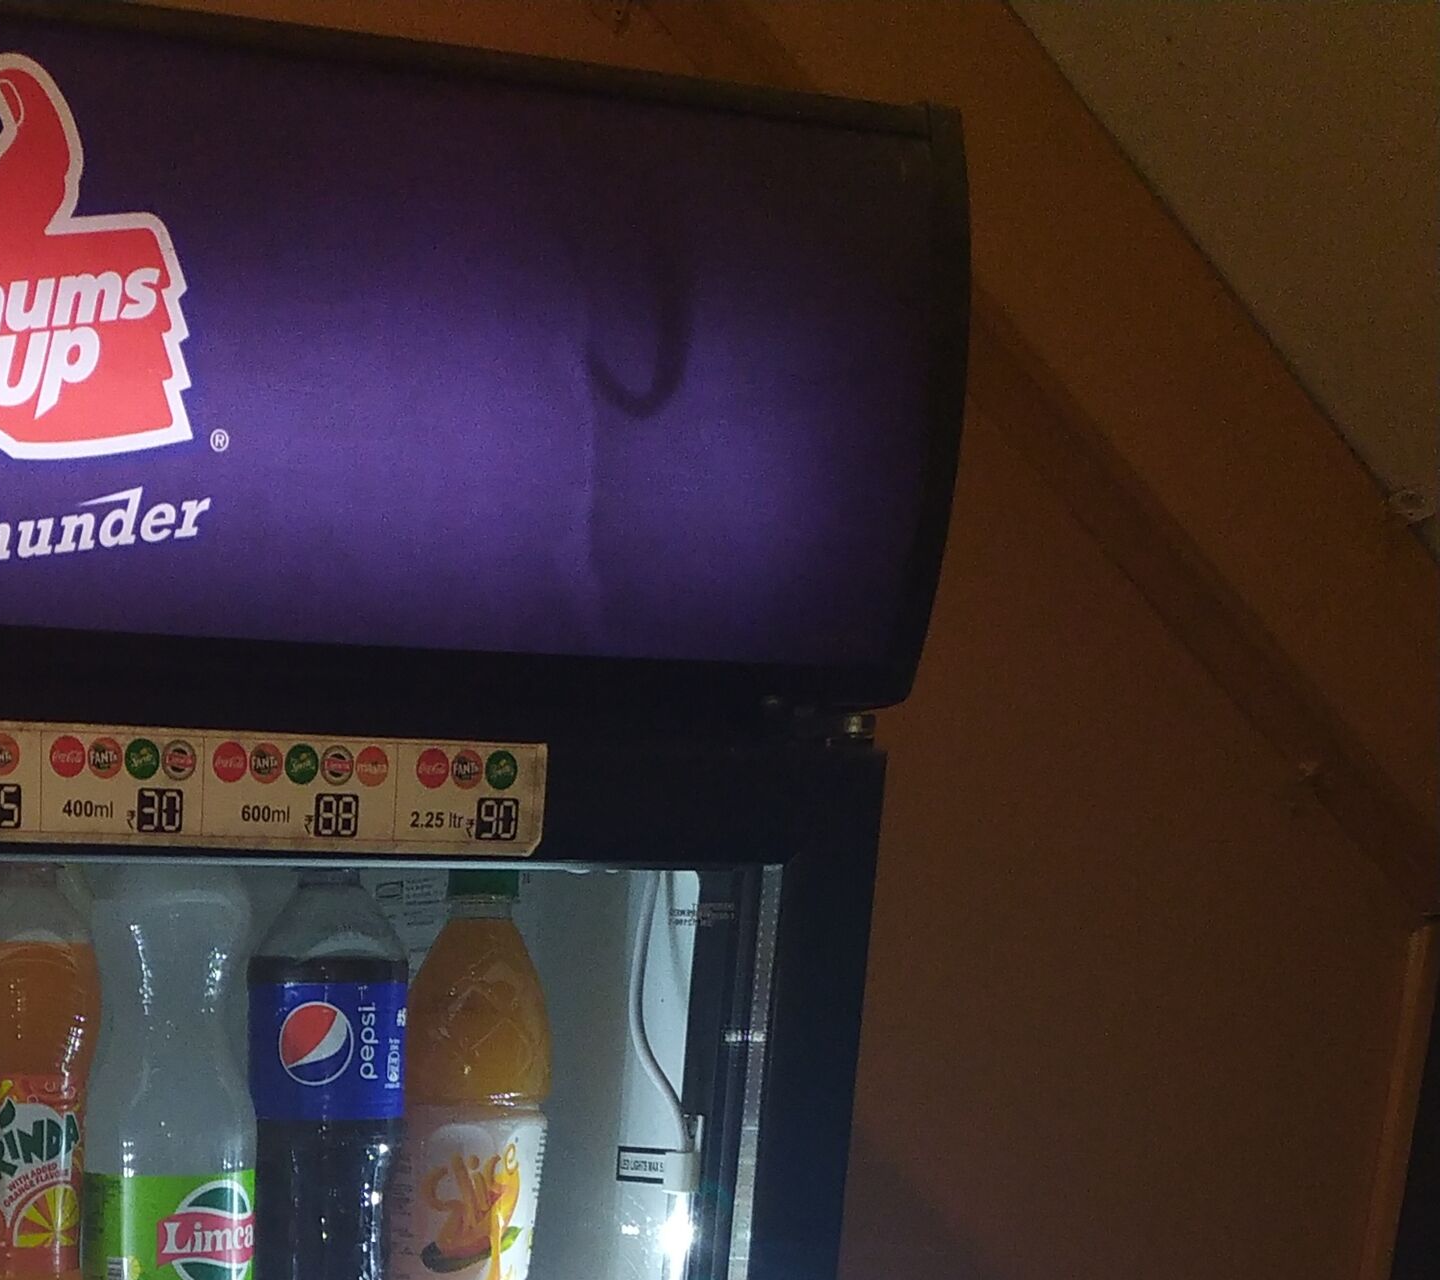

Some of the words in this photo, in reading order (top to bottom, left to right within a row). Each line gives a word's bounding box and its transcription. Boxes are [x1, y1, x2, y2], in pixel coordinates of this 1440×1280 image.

[62, 800, 113, 818] 400ml
[142, 790, 181, 831] 30
[241, 805, 290, 823] 600ml
[410, 811, 444, 828] 2.25
[448, 812, 464, 828] ltr
[480, 800, 516, 838] 90
[358, 1006, 379, 1079] pepsi
[8, 1172, 30, 1191] WITH
[31, 1162, 58, 1178] ADDED
[161, 1221, 254, 1254] Limca
